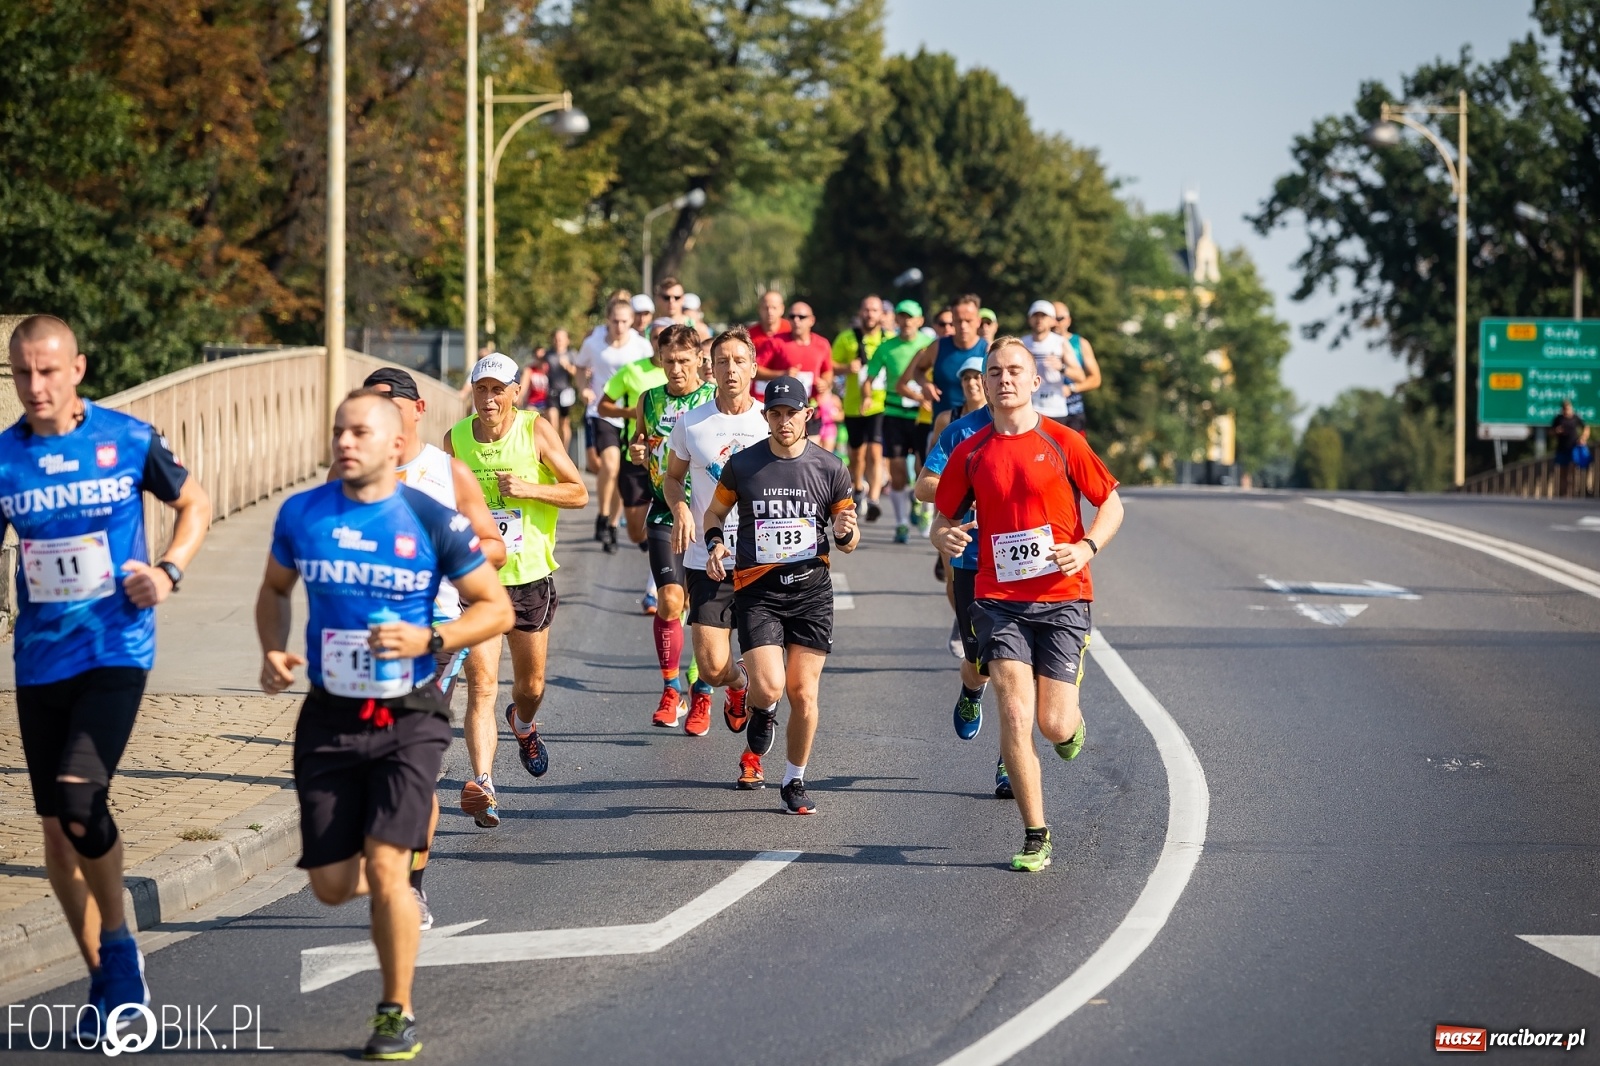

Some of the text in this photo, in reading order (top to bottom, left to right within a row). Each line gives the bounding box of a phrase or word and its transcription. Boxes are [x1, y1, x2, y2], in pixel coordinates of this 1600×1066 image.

[0, 476, 134, 518] RUNNERS
[763, 488, 807, 498] LIVECHAT
[775, 530, 802, 545] 133
[1010, 542, 1041, 561] 298
[56, 555, 79, 577] 11
[658, 626, 675, 667] kalenji
